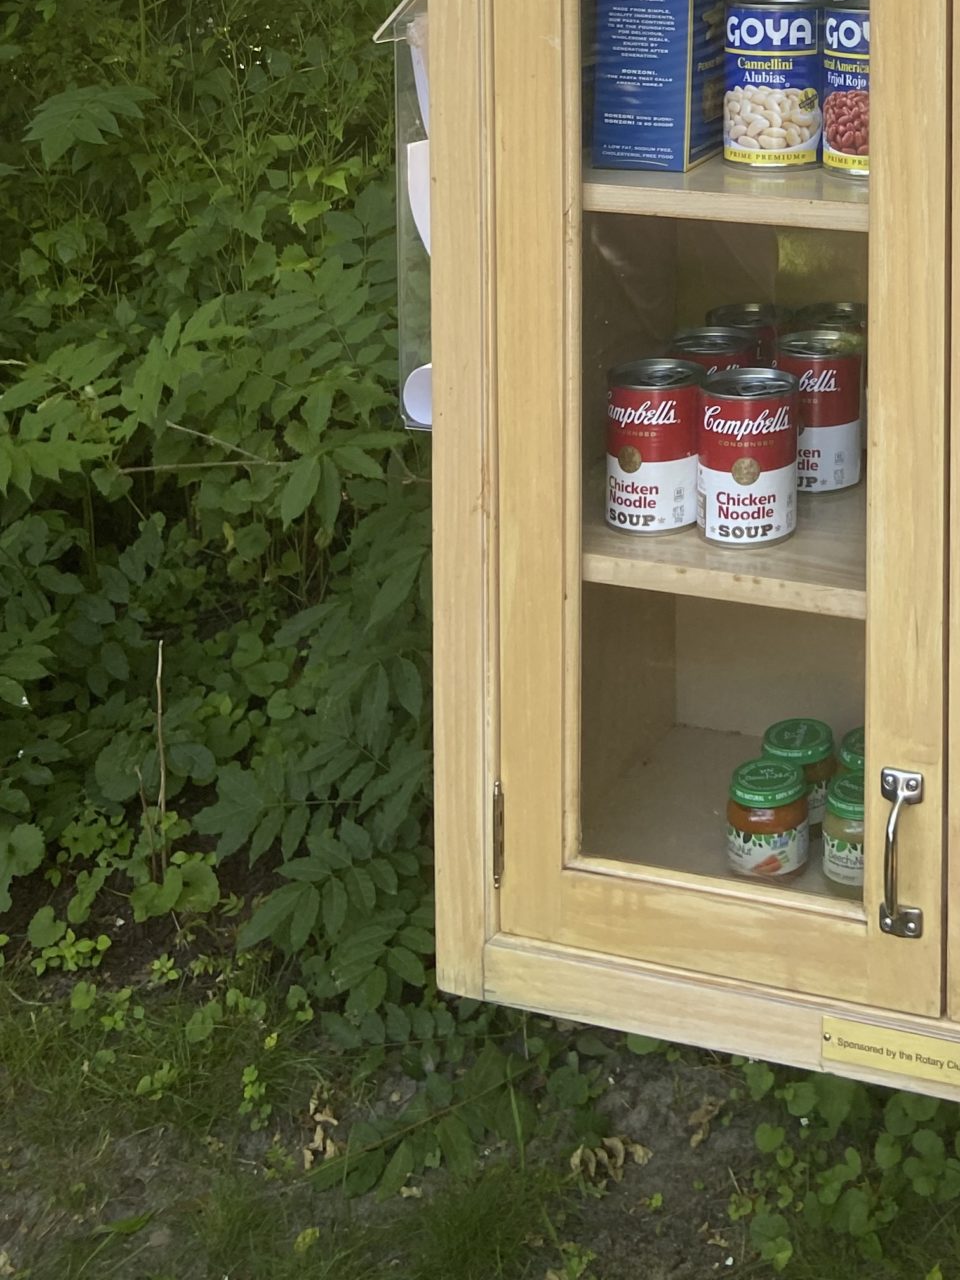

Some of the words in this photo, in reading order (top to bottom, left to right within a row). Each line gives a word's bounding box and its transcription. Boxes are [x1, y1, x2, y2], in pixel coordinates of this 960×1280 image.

[727, 16, 812, 47] GOYA
[737, 57, 793, 70] Cannellini
[743, 71, 786, 84] Alubias
[828, 72, 844, 87] Frijol
[845, 74, 867, 90] Rojo
[729, 151, 752, 160] PRIME
[608, 400, 677, 428] ampbell's
[704, 405, 791, 440] Campbell's
[609, 476, 659, 495] Chicken
[609, 490, 656, 509] Noodle
[716, 491, 777, 507] Chicken
[609, 508, 656, 527] SOUP
[718, 506, 774, 520] Noodle
[718, 523, 774, 539] SOUP
[837, 1037, 884, 1056] Sponsored
[886, 1047, 896, 1060] by
[899, 1050, 913, 1062] the
[915, 1053, 944, 1069] Rotary
